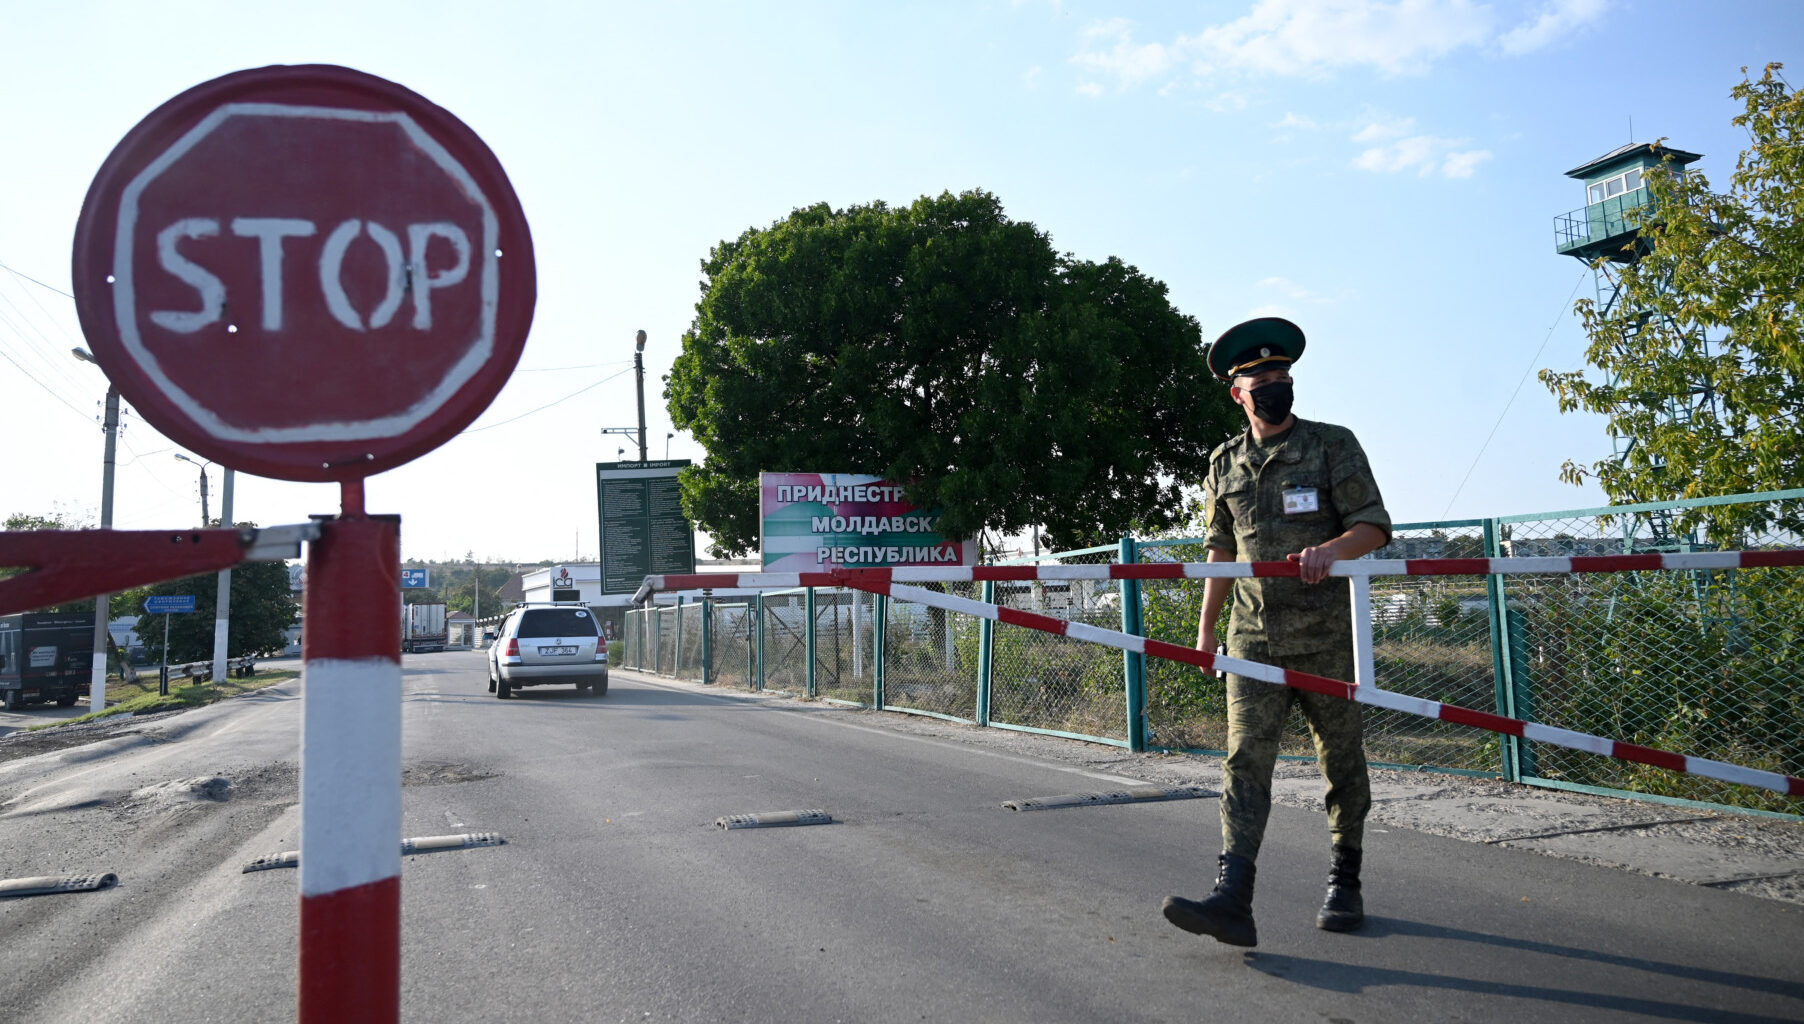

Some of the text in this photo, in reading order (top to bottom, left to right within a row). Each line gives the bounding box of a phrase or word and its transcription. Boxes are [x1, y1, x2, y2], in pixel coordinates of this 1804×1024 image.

[150, 218, 471, 333] STOP
[811, 516, 940, 535] МОЛДАВСК
[817, 546, 957, 563] РЕСПУБЛИКА
